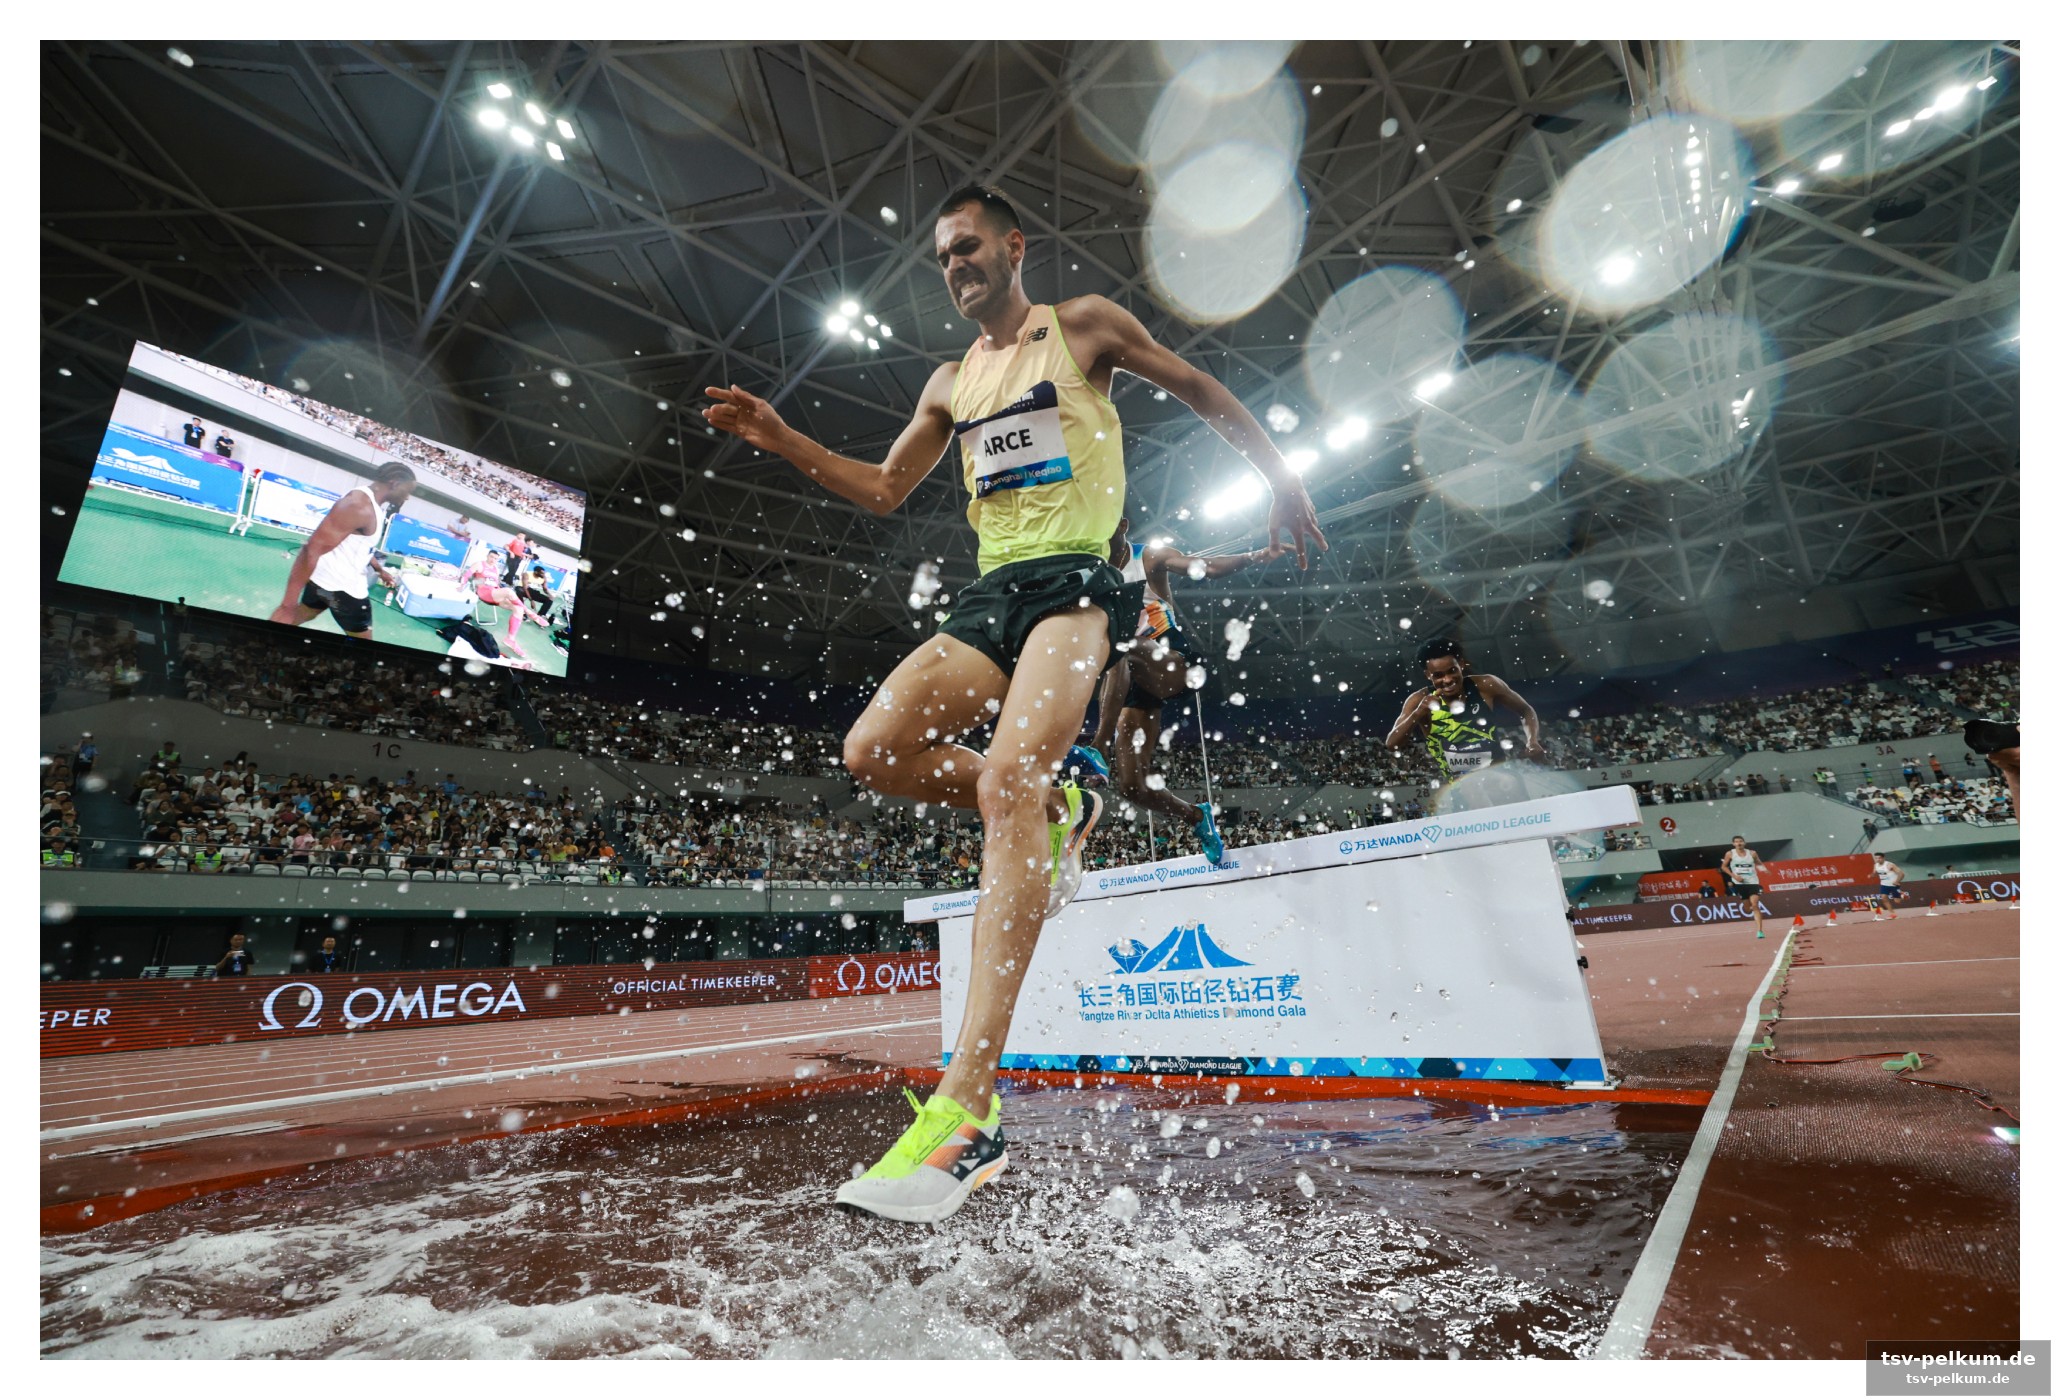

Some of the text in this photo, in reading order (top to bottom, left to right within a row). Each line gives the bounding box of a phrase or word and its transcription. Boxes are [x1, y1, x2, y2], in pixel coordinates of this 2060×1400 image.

[984, 428, 1033, 458] ARCE
[984, 473, 1023, 489] Shanghai
[1029, 465, 1062, 479] Keqiao
[1444, 820, 1500, 838] DIAMOND
[1502, 812, 1551, 829] LEAGUE
[1663, 819, 1673, 830] 2
[1169, 865, 1206, 878] DIAMOND
[1208, 860, 1240, 873] LEAGUE
[1810, 897, 1853, 907] OFFICIAL
[1585, 913, 1633, 924] TIMEKEEPER
[613, 974, 775, 995] OFFICIAL TIMEKEEPER
[1078, 973, 1303, 1008] 长三角国际田径钻石赛
[343, 980, 527, 1024] OMEGA
[1078, 1011, 1115, 1024] Yangtze
[1173, 1006, 1220, 1019] Athletics
[1223, 1005, 1274, 1018] amond
[1277, 1005, 1306, 1017] Gala
[1218, 1062, 1242, 1070] LEAGUE
